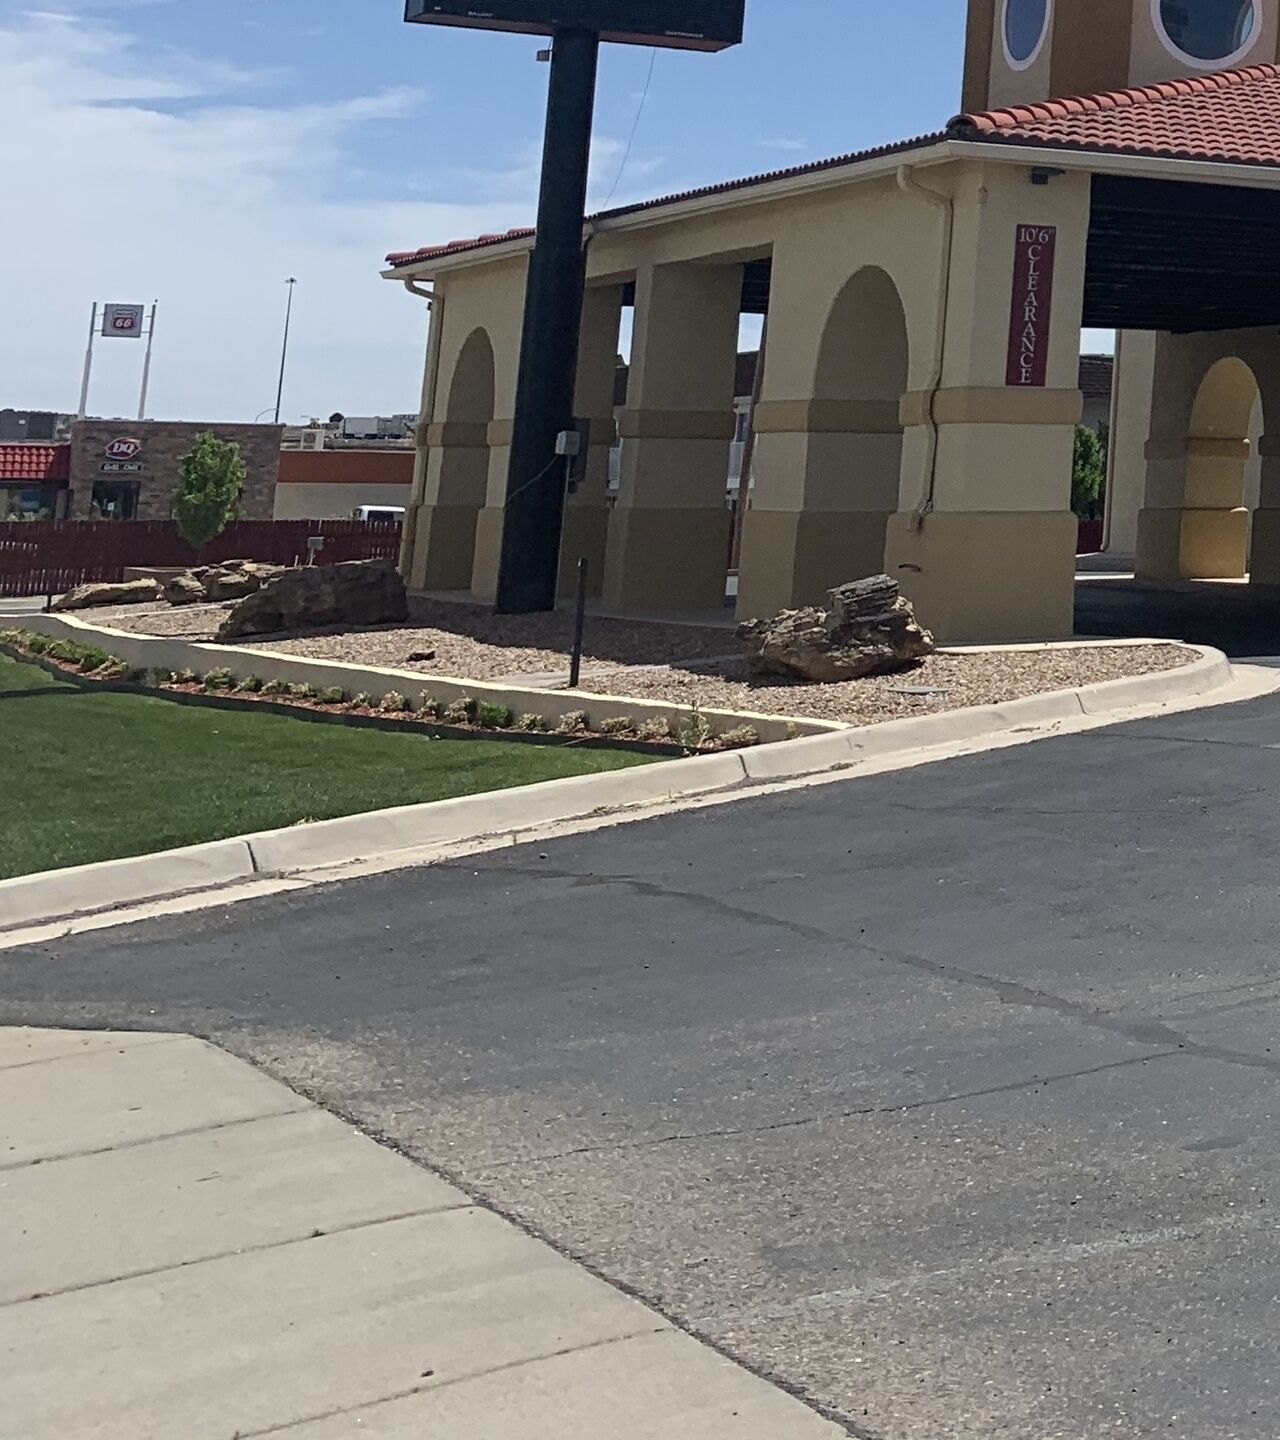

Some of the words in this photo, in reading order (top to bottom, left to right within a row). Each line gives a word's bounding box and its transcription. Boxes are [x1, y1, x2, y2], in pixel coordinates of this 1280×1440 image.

[1019, 244, 1042, 384] CLEARANCE
[115, 318, 132, 328] 66
[112, 442, 135, 454] DQ
